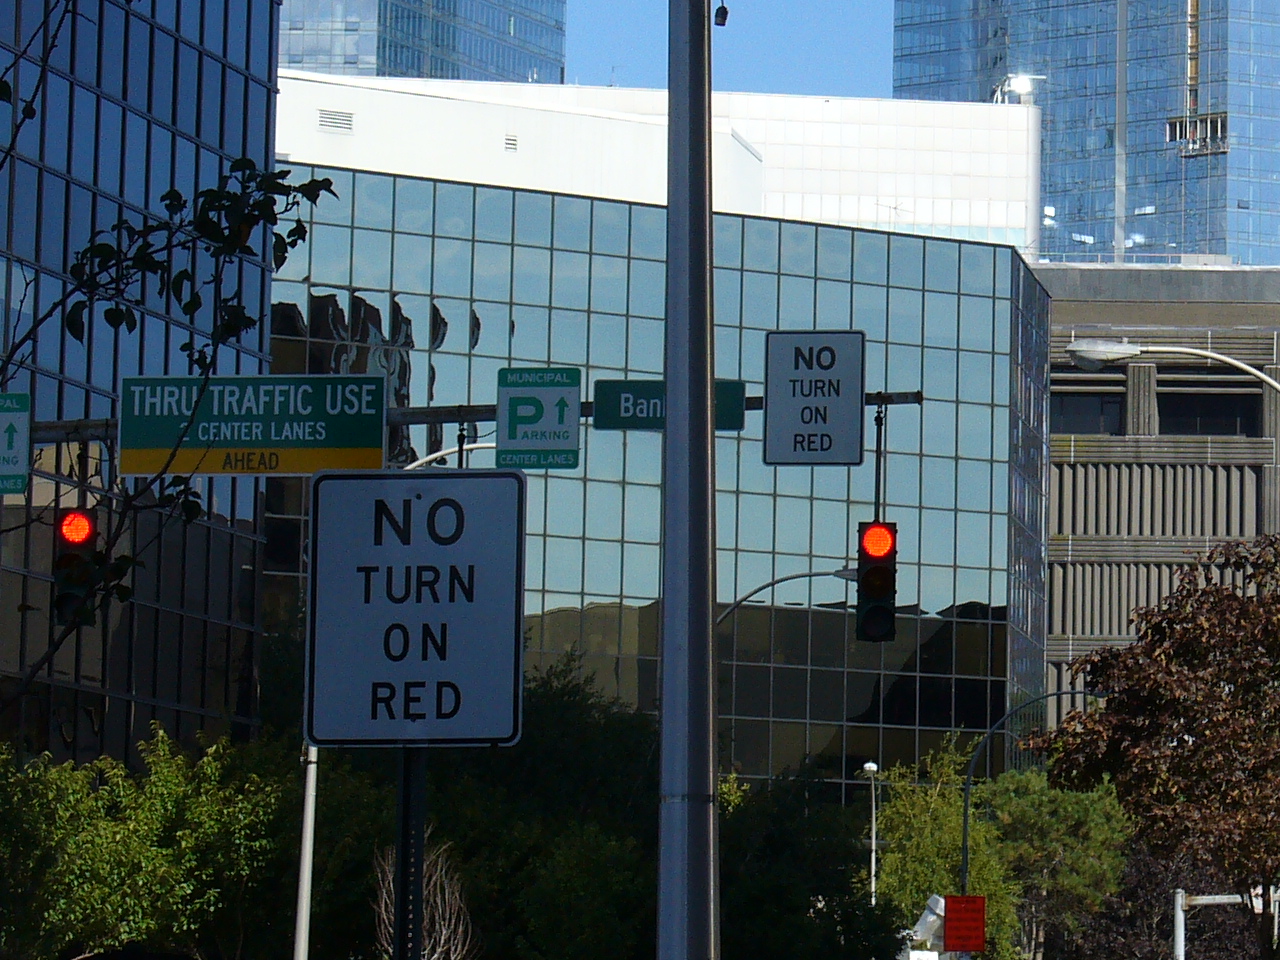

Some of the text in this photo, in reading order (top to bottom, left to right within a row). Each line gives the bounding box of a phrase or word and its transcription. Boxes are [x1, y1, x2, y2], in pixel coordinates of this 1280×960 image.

[794, 345, 836, 371] NO
[507, 373, 570, 383] MUNICIPAL
[789, 379, 841, 397] TURN
[130, 384, 376, 416] THRU TRAFFIC USE
[620, 392, 666, 418] Ban
[800, 405, 827, 425] ON
[198, 421, 263, 441] CENTER
[271, 421, 326, 440] LANES
[793, 433, 833, 452] RED
[222, 451, 279, 471] AHEAD
[500, 454, 574, 464] CENTER LANES
[373, 497, 465, 546] NO
[356, 564, 475, 604] TURN
[383, 622, 448, 662] ON
[370, 680, 462, 721] RED
